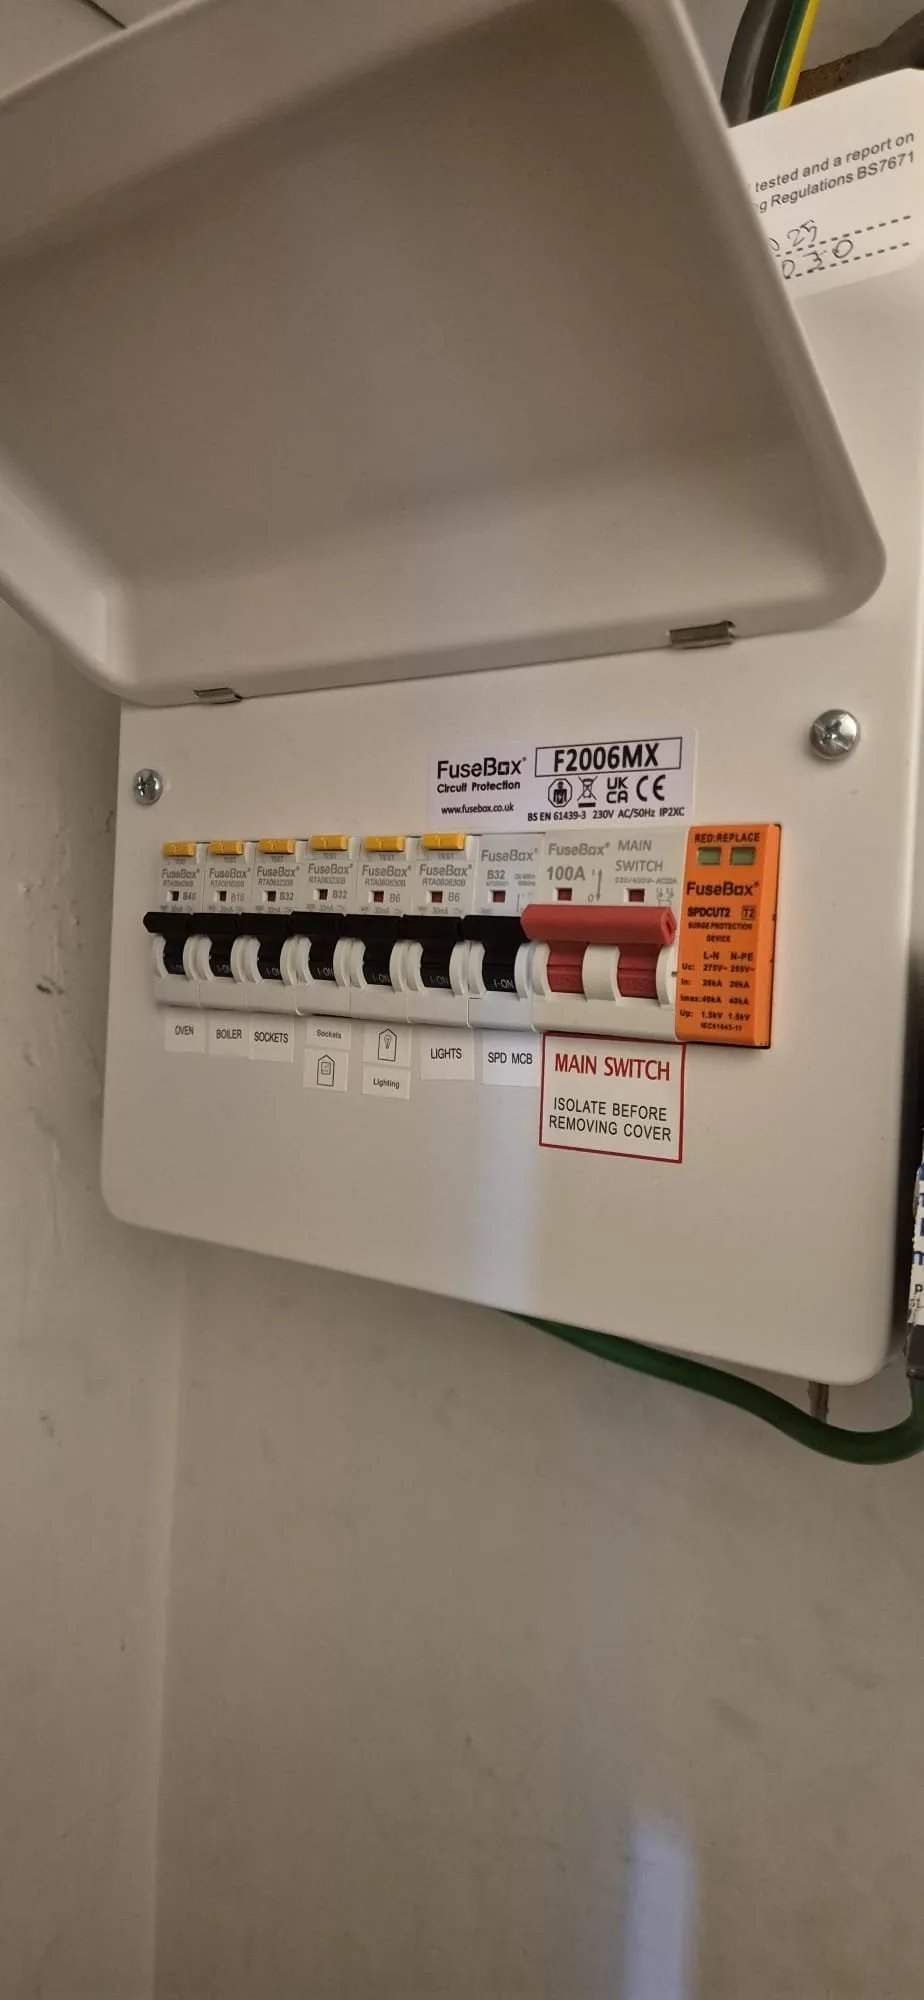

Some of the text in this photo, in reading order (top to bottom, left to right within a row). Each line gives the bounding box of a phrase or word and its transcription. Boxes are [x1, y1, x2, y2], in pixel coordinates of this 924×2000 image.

[755, 132, 915, 192] tested and a report on
[771, 173, 853, 207] Regulations
[857, 151, 915, 180] BS7671
[554, 743, 660, 772] F2006MX
[437, 757, 522, 779] FuseBox
[437, 780, 521, 793] Circuit Protection
[441, 802, 515, 814] www.fusebox.co.uk
[528, 806, 685, 821] BS EN 61439-3 230V AC/50Hz IP2XC
[618, 840, 652, 852] MAIN
[615, 860, 664, 872] SWITCH
[487, 869, 506, 880] B32
[546, 866, 586, 880] 100A
[333, 890, 347, 899] B32
[686, 881, 753, 896] FuseBox
[280, 892, 294, 901] B32
[389, 893, 401, 903] B6
[448, 892, 460, 902] B6
[688, 906, 730, 918] SPDCUT2
[703, 951, 753, 961] L-N N-PE
[175, 1025, 194, 1036] OVEN
[216, 1029, 242, 1039] BOILER
[316, 1029, 341, 1039] Sockets
[254, 1031, 289, 1043] SOCKETS
[430, 1048, 462, 1059] LIGHTS
[488, 1052, 533, 1064] SPD MCB
[555, 1053, 670, 1081] MAIN SWITCH
[373, 1077, 400, 1089] Lighting
[554, 1097, 667, 1121] ISOLATE BEFORE
[549, 1115, 671, 1142] REMOVING COVER
